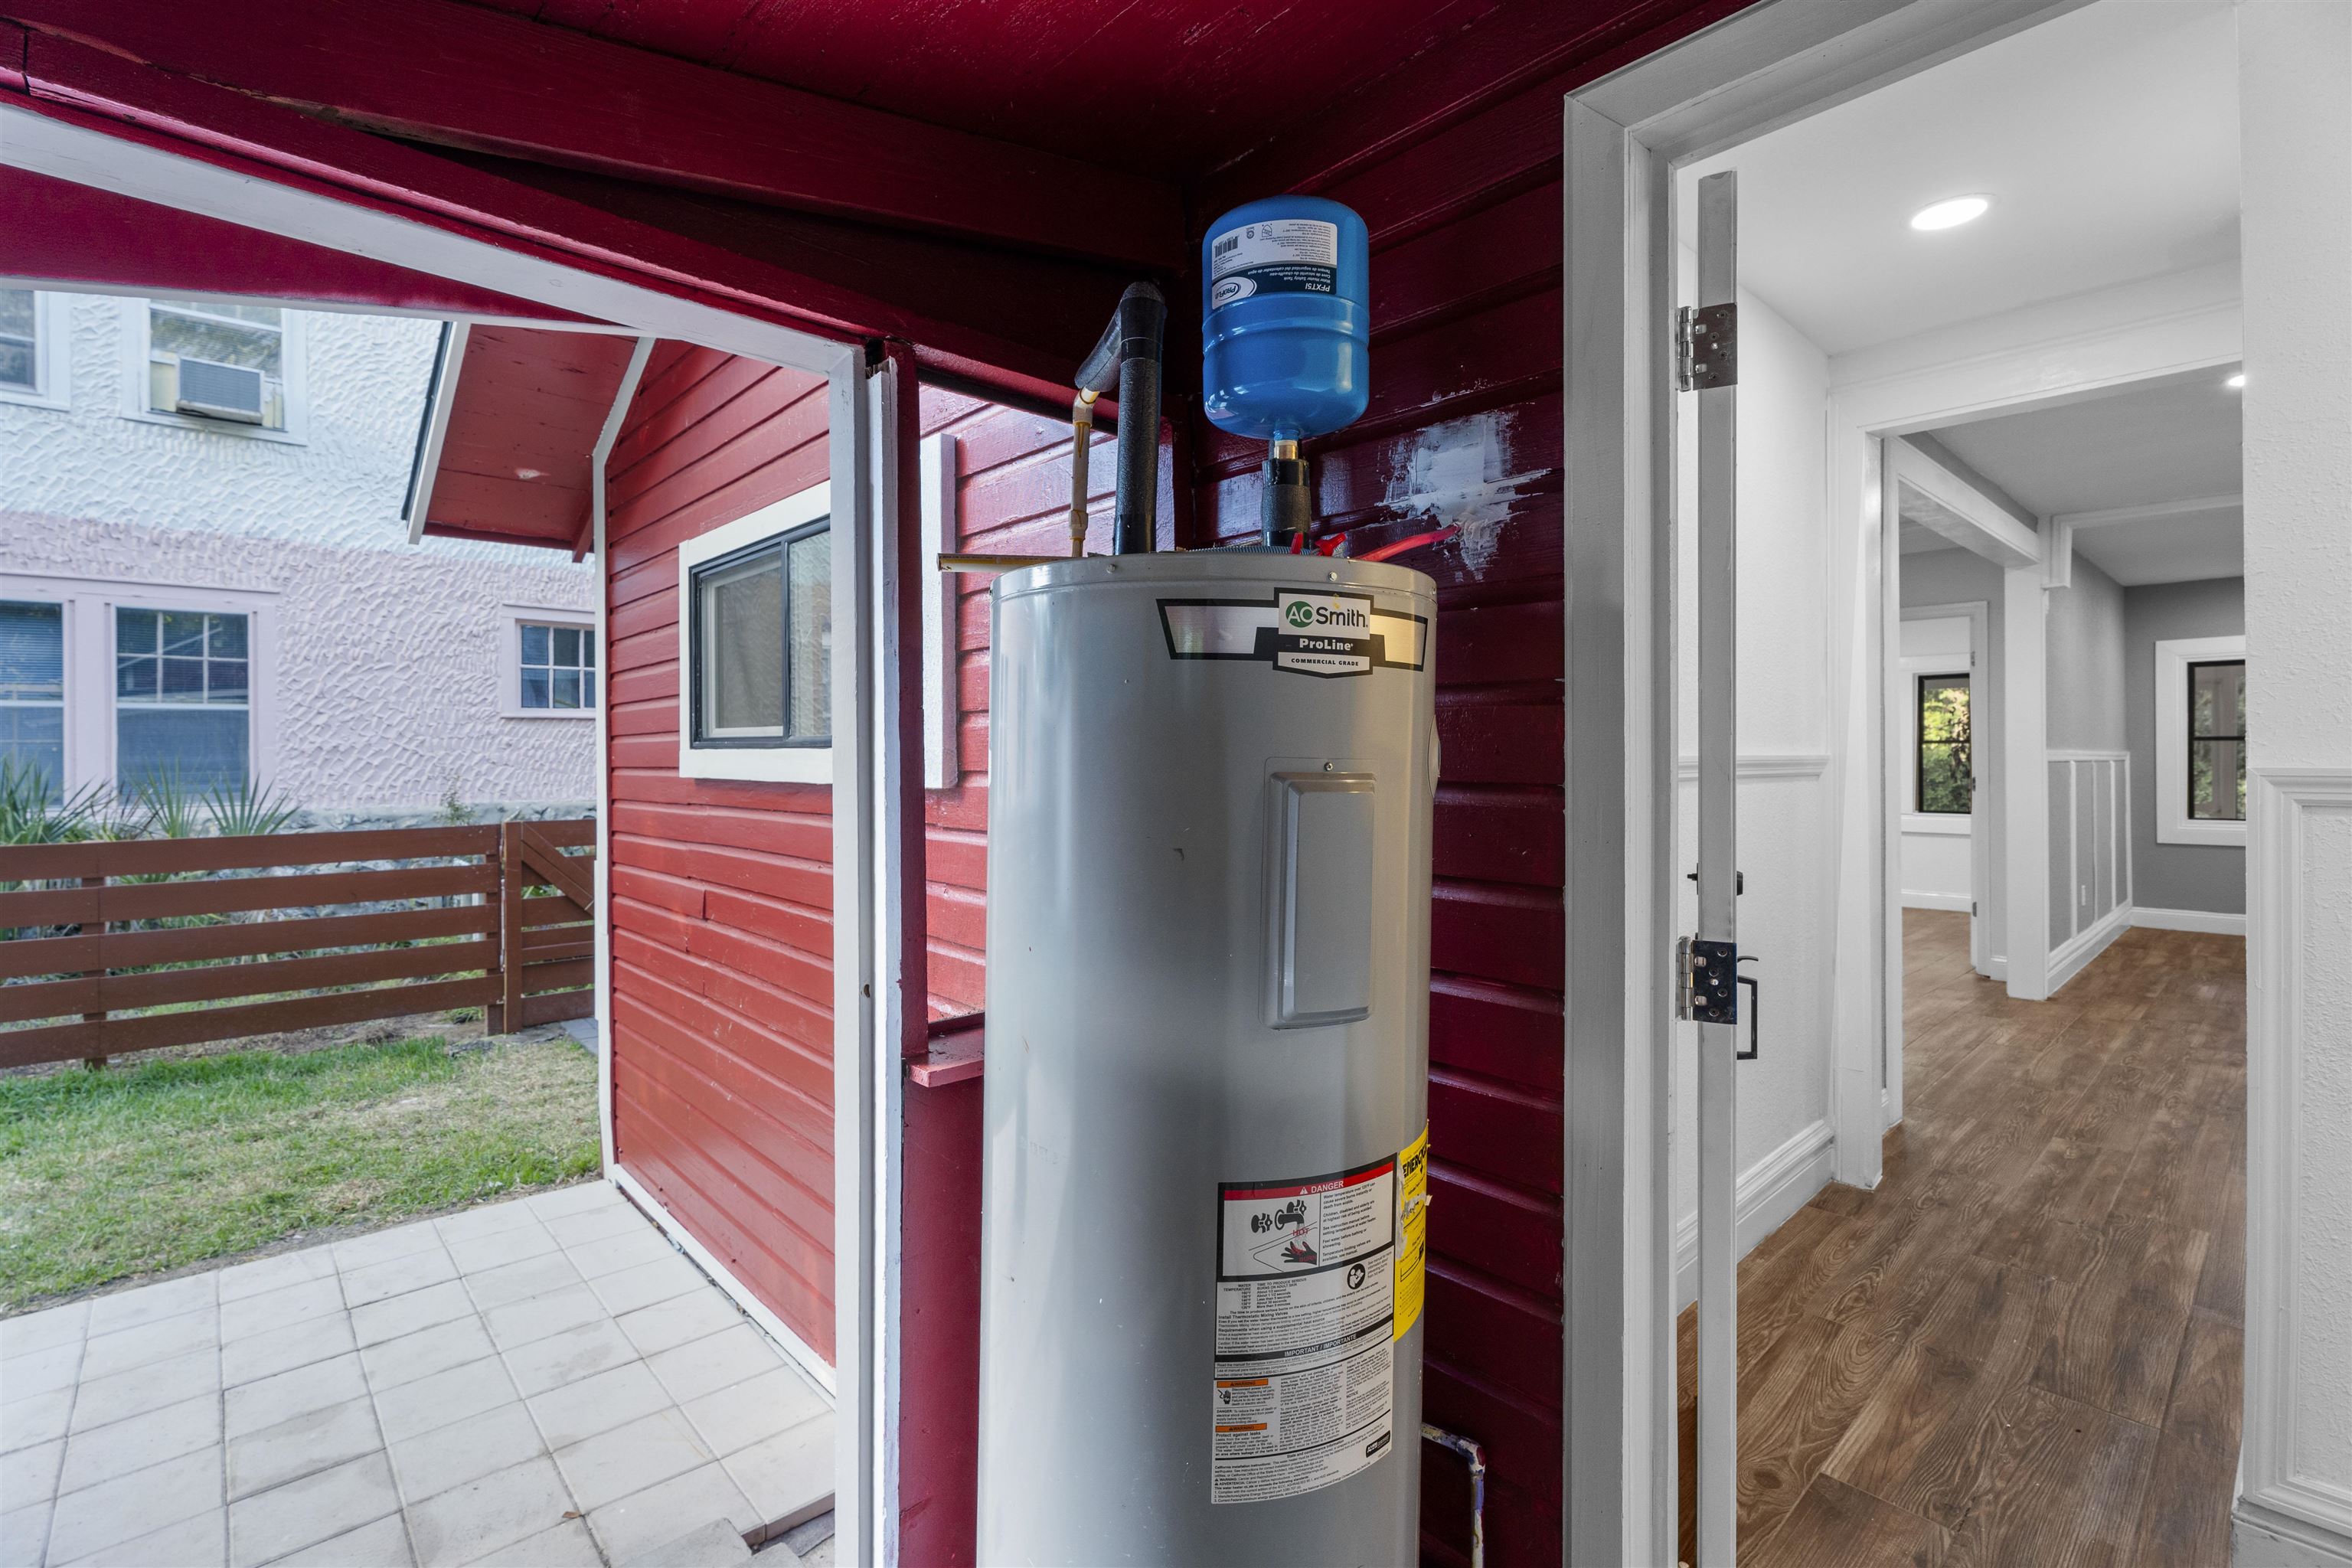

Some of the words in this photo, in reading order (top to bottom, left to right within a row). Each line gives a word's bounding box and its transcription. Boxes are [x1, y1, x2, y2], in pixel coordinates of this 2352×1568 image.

[1311, 1180, 1343, 1193] DANGER
[1334, 1188, 1353, 1197] temperature
[1330, 1220, 1348, 1229] instruction
[1335, 1224, 1354, 1233] temperature
[1322, 1248, 1343, 1257] Temperature
[1344, 1244, 1356, 1252] limiting
[1284, 1345, 1319, 1356] IMPORTANT
[1323, 1333, 1356, 1349] IMPORTANTE
[1346, 1390, 1358, 1399] NOTICE
